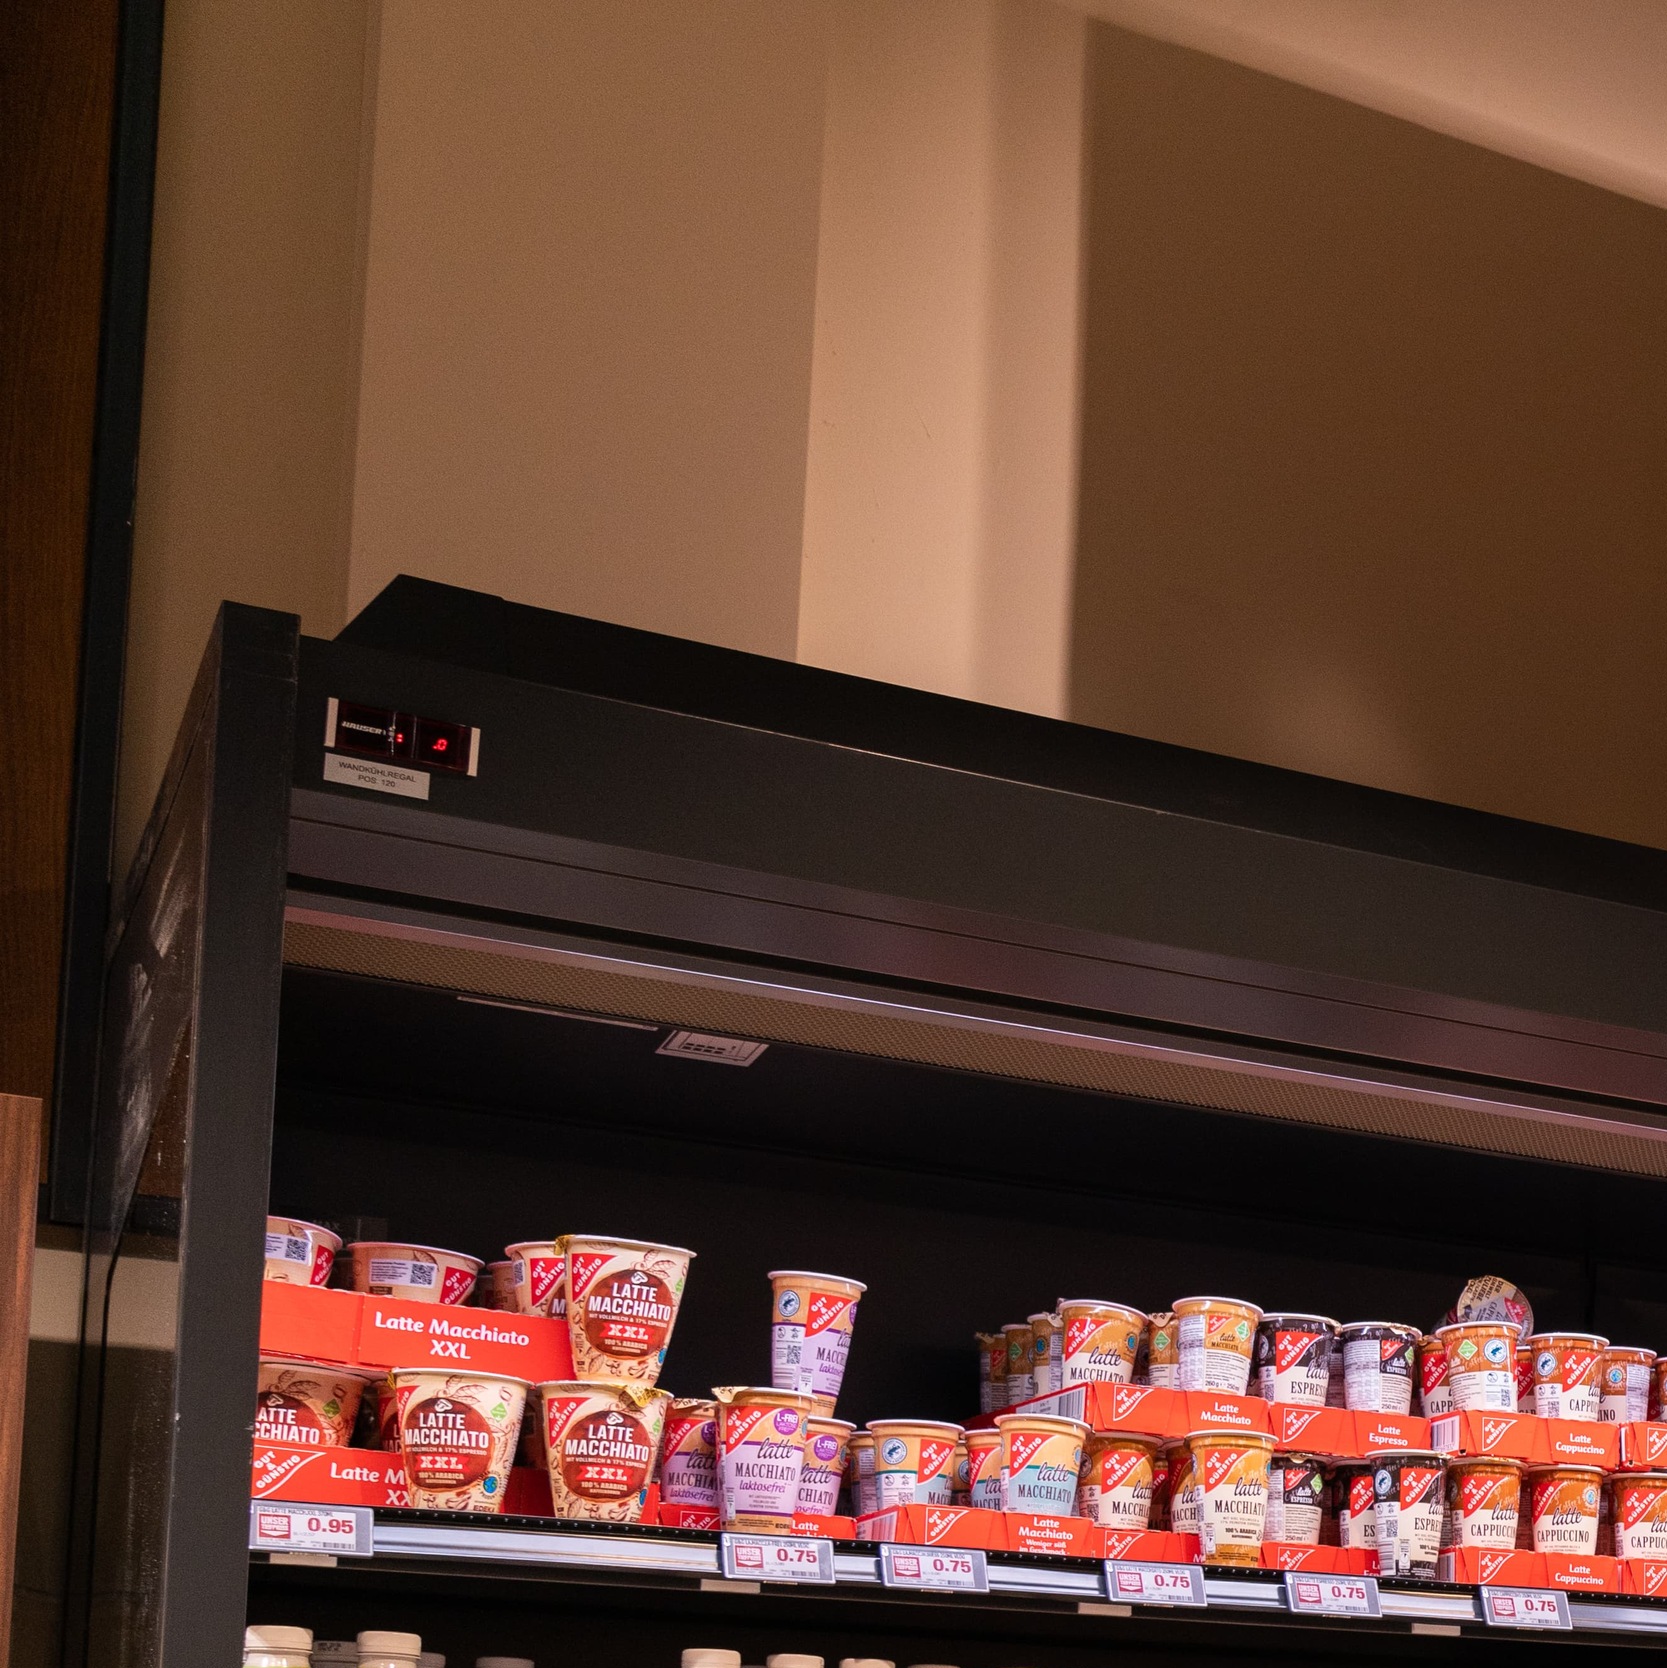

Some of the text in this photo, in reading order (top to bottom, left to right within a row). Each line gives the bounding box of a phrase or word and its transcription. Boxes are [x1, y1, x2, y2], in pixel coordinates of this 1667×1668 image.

[339, 761, 416, 782] WANDKÜHLREGAL
[381, 780, 396, 788] 120
[612, 1282, 657, 1303] LATTE
[588, 1296, 671, 1322] MACCHIATO
[375, 1312, 530, 1347] Latte Macchiato
[607, 1324, 648, 1339] XXL
[430, 1339, 471, 1360] XXL
[1200, 1409, 1252, 1425] Macchiato
[1214, 1402, 1239, 1417] Latte
[1377, 1423, 1401, 1437] Latte
[1368, 1432, 1408, 1446] Espresso
[1555, 1438, 1605, 1455] Cappuccino
[1568, 1433, 1591, 1446] Latte
[757, 1438, 793, 1460] latte
[330, 1462, 380, 1483] Latte
[734, 1462, 796, 1481] MACCHIATO
[739, 1478, 788, 1493] laktosefrei
[260, 1516, 289, 1525] UNSER
[308, 1518, 354, 1534] 0.95
[1033, 1517, 1060, 1529] Latte
[1019, 1527, 1073, 1541] Macchiato
[1026, 1539, 1052, 1549] Weniger
[777, 1548, 818, 1564] 0.75
[932, 1559, 972, 1574] 0.75
[1524, 1599, 1557, 1613] 0.75
